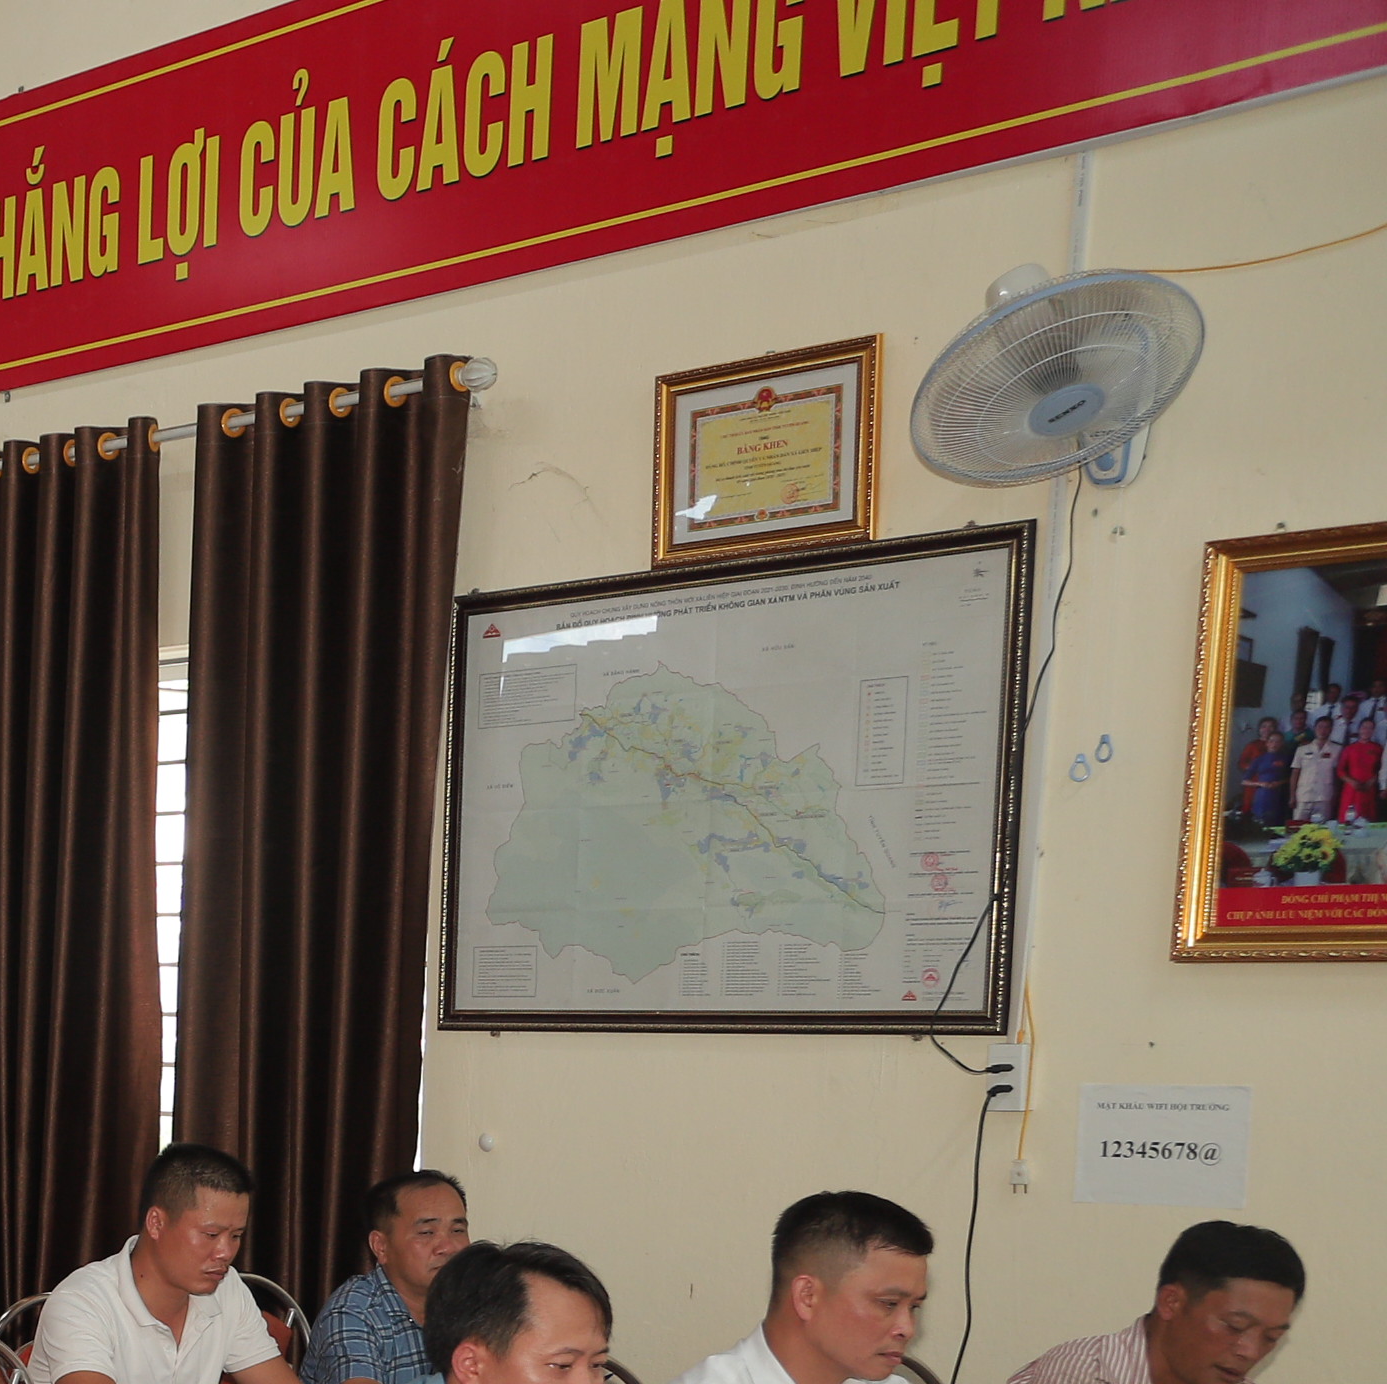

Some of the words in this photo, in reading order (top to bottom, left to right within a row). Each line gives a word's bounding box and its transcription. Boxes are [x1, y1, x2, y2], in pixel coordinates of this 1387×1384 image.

[138, 127, 220, 281] LỢI
[239, 68, 355, 237] CỦA
[376, 37, 553, 200] CÁCH
[576, 0, 805, 158] MẠNG
[1099, 1140, 1222, 1166] 12345678@
